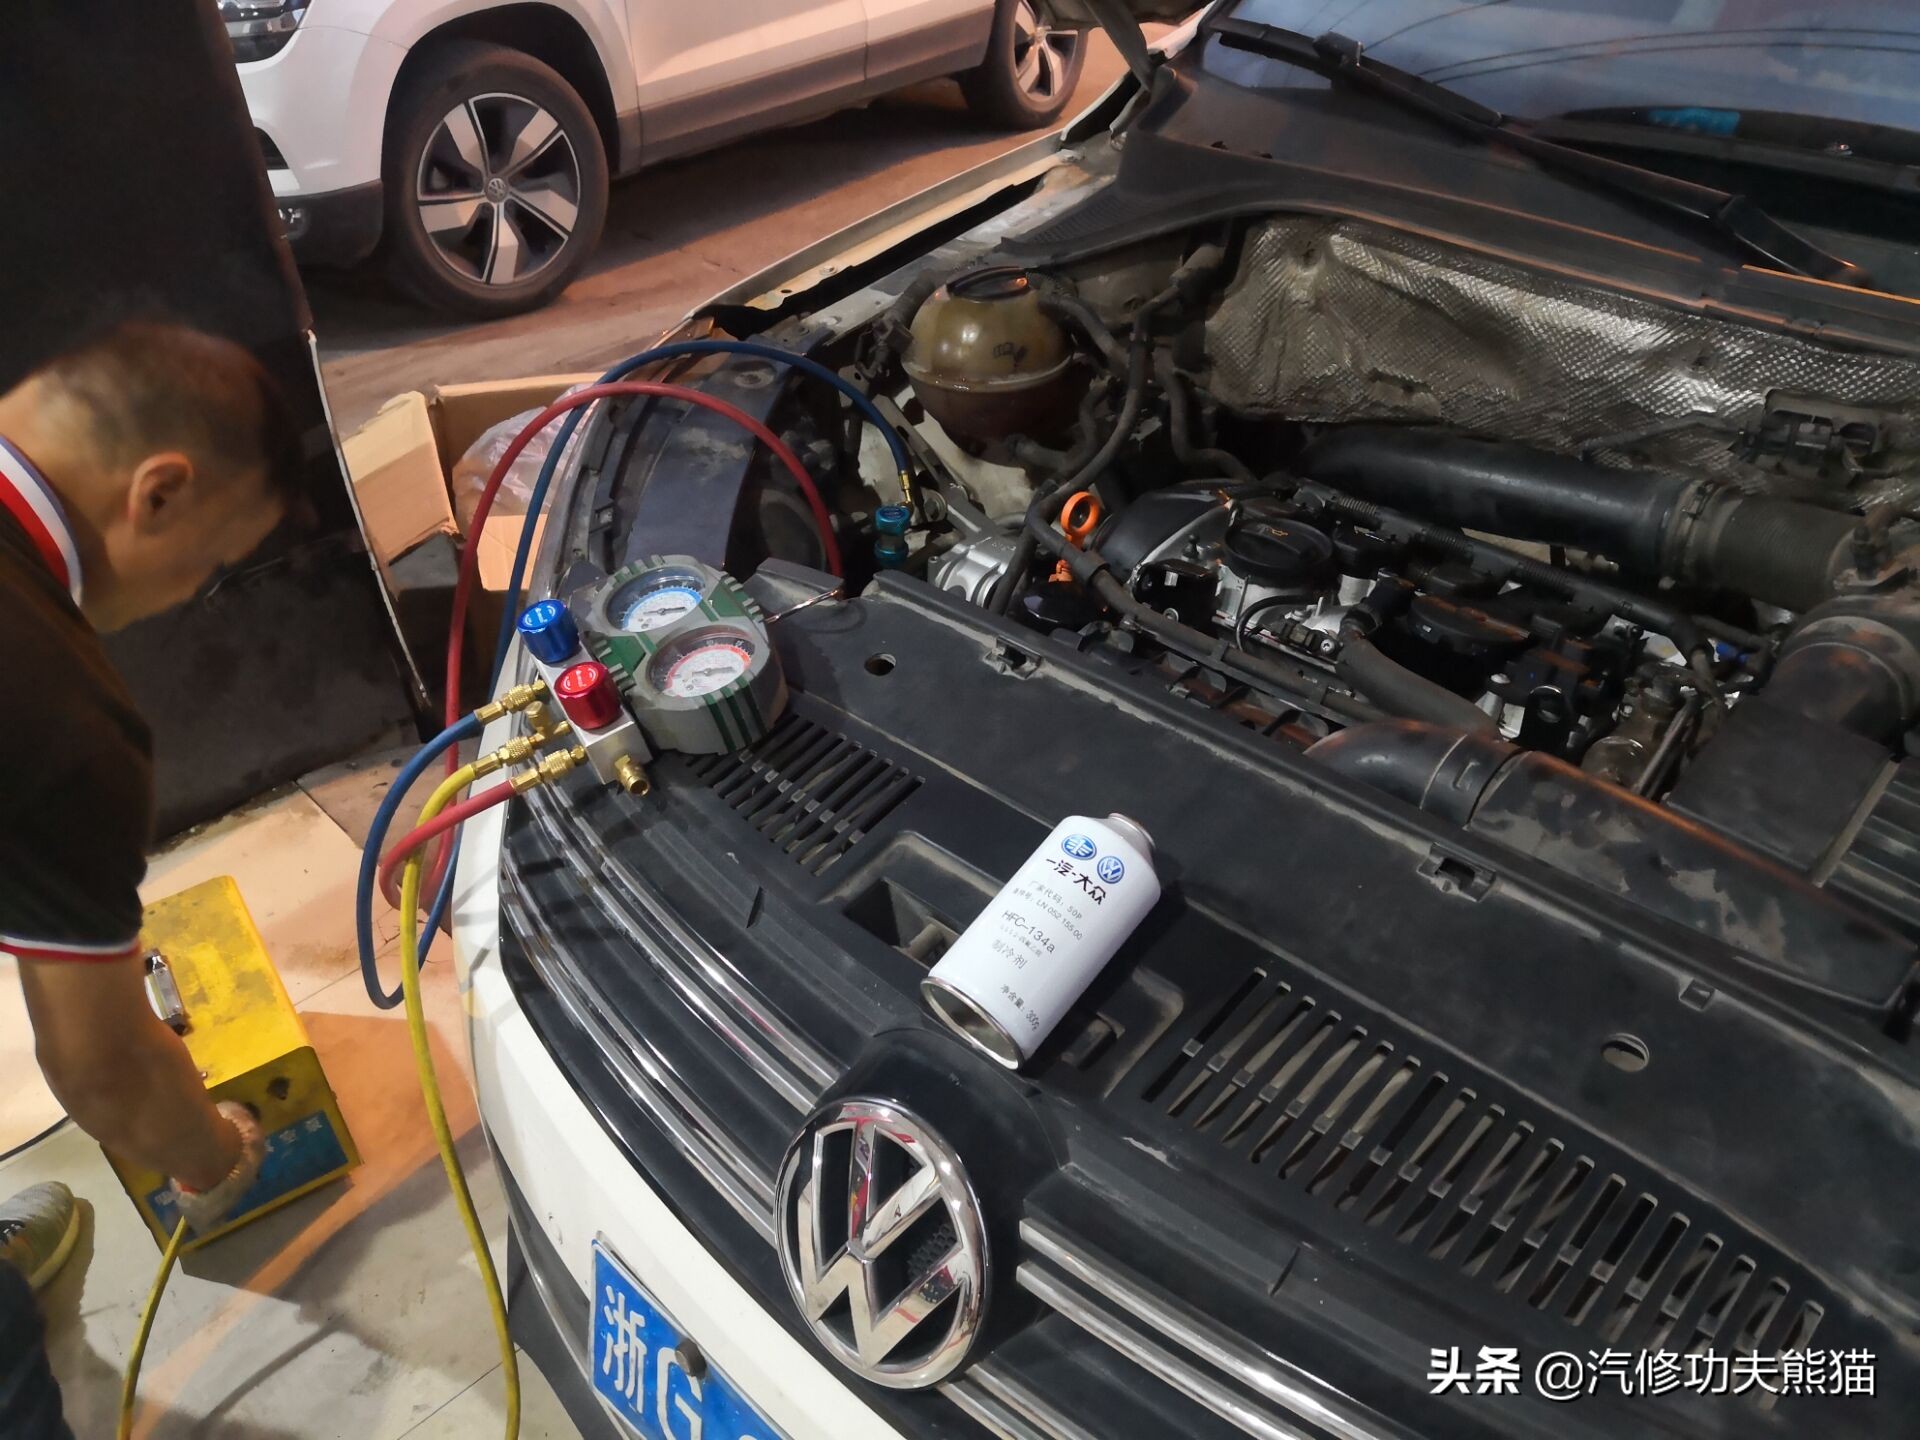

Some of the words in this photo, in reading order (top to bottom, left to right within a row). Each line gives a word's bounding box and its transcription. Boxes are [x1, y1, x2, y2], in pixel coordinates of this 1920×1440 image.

[1046, 859, 1106, 905] 一汽-大众
[1002, 910, 1055, 954] HFC-134a
